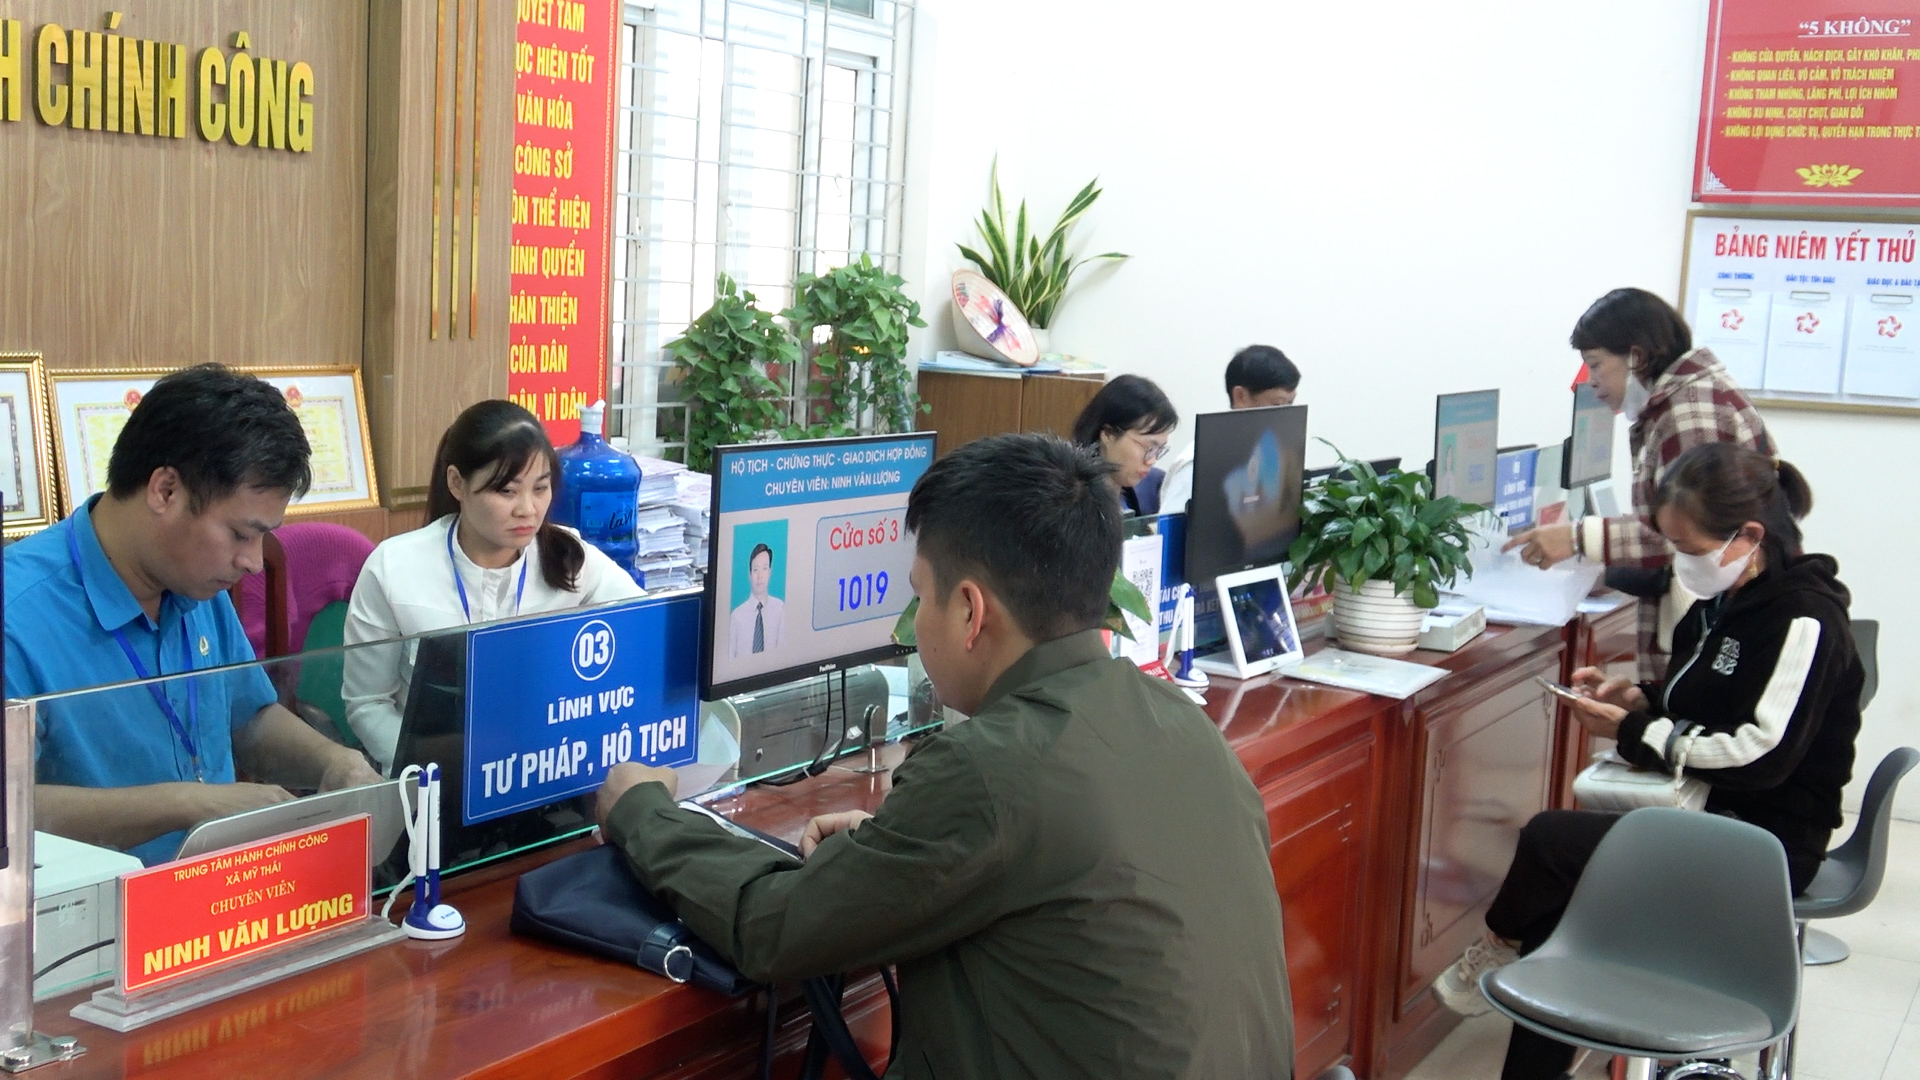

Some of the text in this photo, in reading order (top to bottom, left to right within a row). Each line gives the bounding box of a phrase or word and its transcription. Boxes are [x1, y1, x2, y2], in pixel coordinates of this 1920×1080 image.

[37, 12, 187, 138] CHÍNH
[200, 31, 314, 152] CÔNG
[536, 43, 568, 85] HIỆN
[571, 44, 595, 84] TỐT
[517, 89, 574, 130] VĂN HÓA
[514, 140, 574, 180] CÔNG SỞ
[532, 187, 556, 227] THỂ
[559, 194, 591, 235] HIỆN
[541, 239, 585, 280] QUYỀN
[1715, 225, 1916, 263] BẢNG NIÊM YẾT THỦ
[540, 290, 578, 331] THIỆN
[509, 335, 568, 374] CỦA DÂN
[544, 386, 557, 421] VÌ
[731, 458, 745, 476] HỘ
[748, 459, 768, 475] TỊCH
[776, 453, 810, 470] CHỨNG
[813, 453, 835, 469] THỰC
[843, 451, 863, 464] GIAO
[865, 449, 885, 464] DỊCH
[887, 448, 902, 461] HỢP
[904, 446, 927, 459] ĐỒNG
[765, 470, 900, 496] CHUYÊN VIÊN: NINH VĂN LƯỢNG
[829, 517, 898, 550] Cửa số 3
[838, 570, 889, 612] 1019
[578, 629, 610, 668] 03
[548, 686, 634, 725] LĨNH VỰC
[481, 753, 517, 798] TƯ
[521, 737, 594, 789] PHÁP,
[639, 715, 687, 762] TỊCH
[174, 833, 328, 882] TRUNG TÂM HÀNH CHÍNH CÔNG
[226, 861, 281, 886] XÃ MỸ THÁI
[210, 880, 296, 915] CHUYÊN VIÊN
[143, 892, 353, 976] NINH VĂN LƯỢNG
